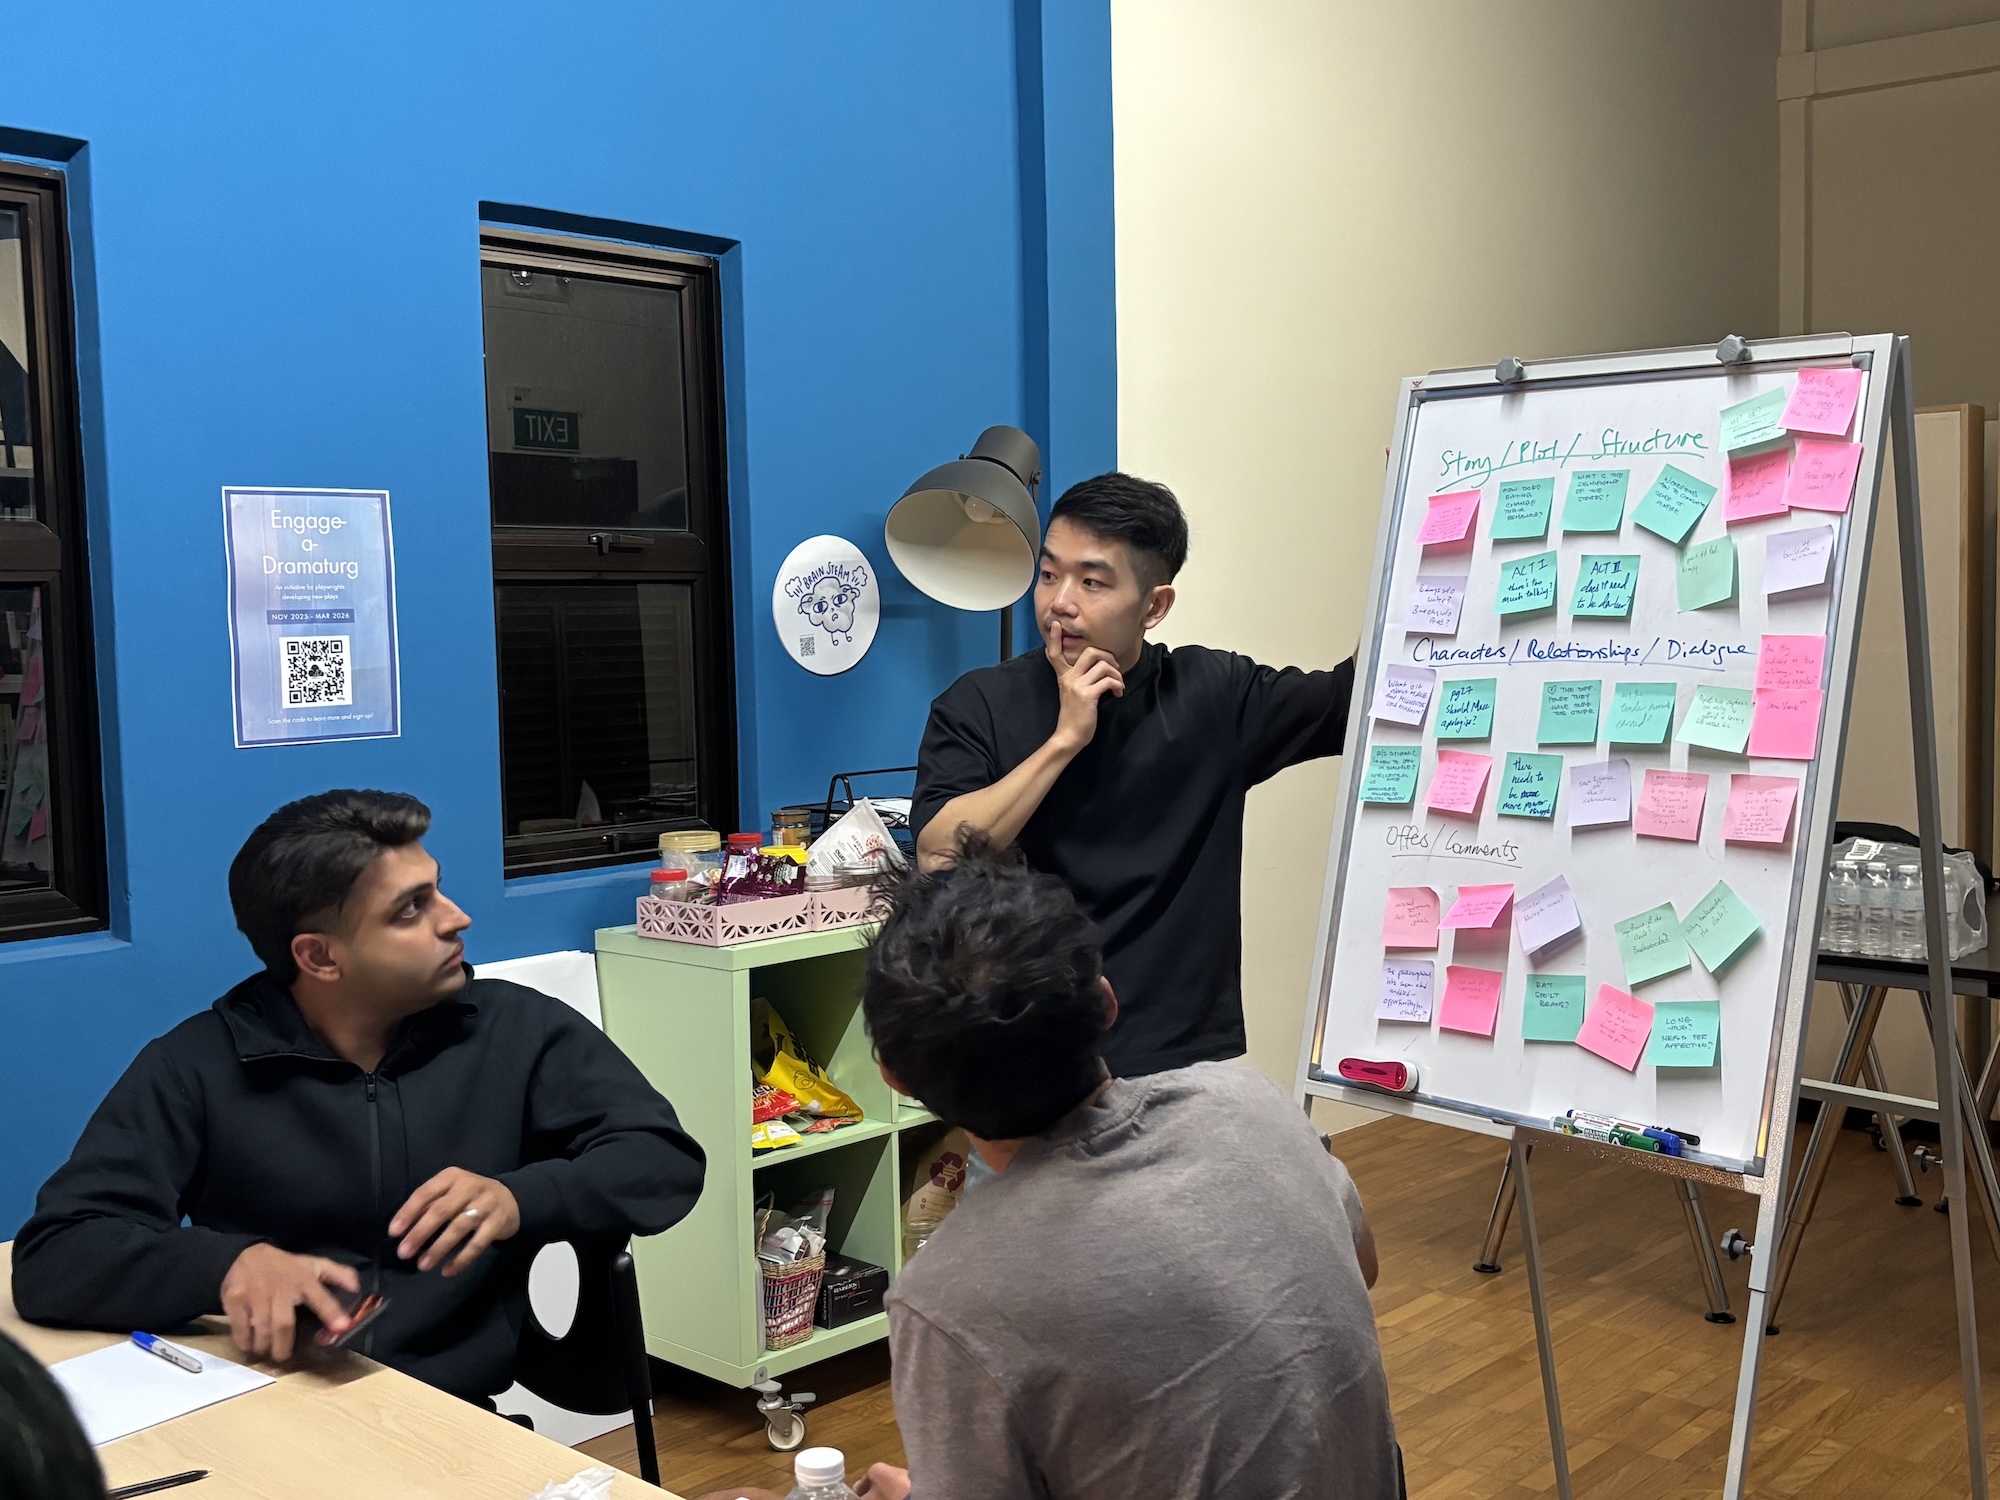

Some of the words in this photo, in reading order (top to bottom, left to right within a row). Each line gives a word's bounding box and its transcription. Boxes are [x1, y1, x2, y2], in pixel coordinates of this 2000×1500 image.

[1440, 451, 1492, 488] Story
[1520, 440, 1559, 464] Plot
[1592, 428, 1709, 461] Structure
[271, 510, 347, 535] Engage-
[301, 538, 319, 552] a-
[263, 555, 359, 580] Dramaturg
[1512, 562, 1536, 580] ACT
[1591, 562, 1611, 575] ACT
[803, 566, 825, 590] BRAIN
[826, 561, 850, 583] STEAM
[315, 583, 346, 591] playwrights
[282, 593, 311, 601] developing
[1502, 593, 1523, 603] much
[1577, 597, 1585, 609] to
[1587, 594, 1598, 608] be
[271, 613, 288, 621] NOV
[315, 612, 330, 620] MAR
[332, 612, 350, 620] 2026
[1413, 637, 1507, 663] Characters
[1527, 639, 1640, 666] Relationships
[1668, 638, 1757, 666] Dialogue
[1446, 701, 1470, 714] Should
[1512, 771, 1533, 784] needs
[1536, 771, 1544, 781] to
[1509, 787, 1518, 799] be
[1502, 802, 1521, 810] more
[1540, 1000, 1569, 1009] BEANS?
